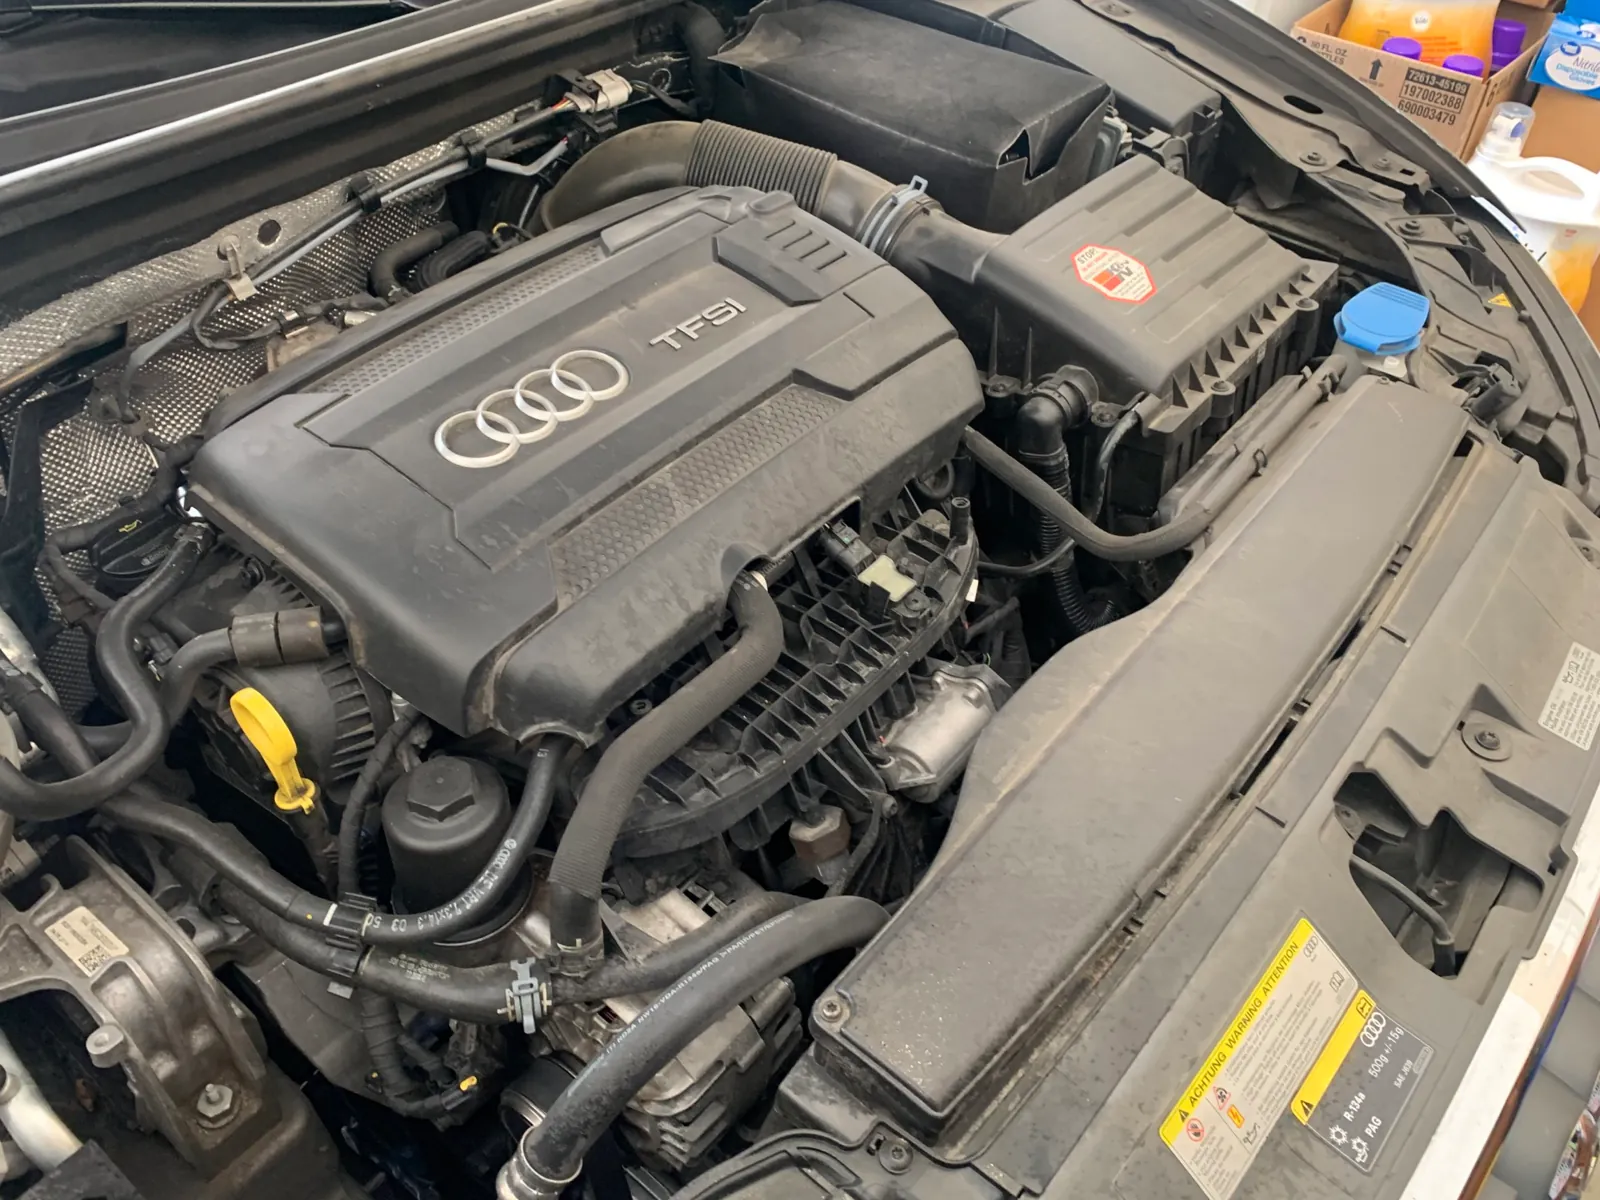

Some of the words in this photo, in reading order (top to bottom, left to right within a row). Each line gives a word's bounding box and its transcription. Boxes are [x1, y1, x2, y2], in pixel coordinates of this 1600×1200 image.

[1408, 69, 1468, 94] 72613-45199
[1403, 83, 1462, 110] 197002388
[1398, 100, 1456, 126] 690003479
[648, 297, 747, 351] TFSI
[391, 919, 407, 932] 03
[1188, 1052, 1227, 1108] ACHTUNG
[1226, 997, 1262, 1050] WARNING
[1263, 942, 1300, 997] ATTENTION
[1343, 1091, 1366, 1122] R-134a
[1368, 1053, 1389, 1079] 500g
[1365, 1116, 1382, 1138] PAG
